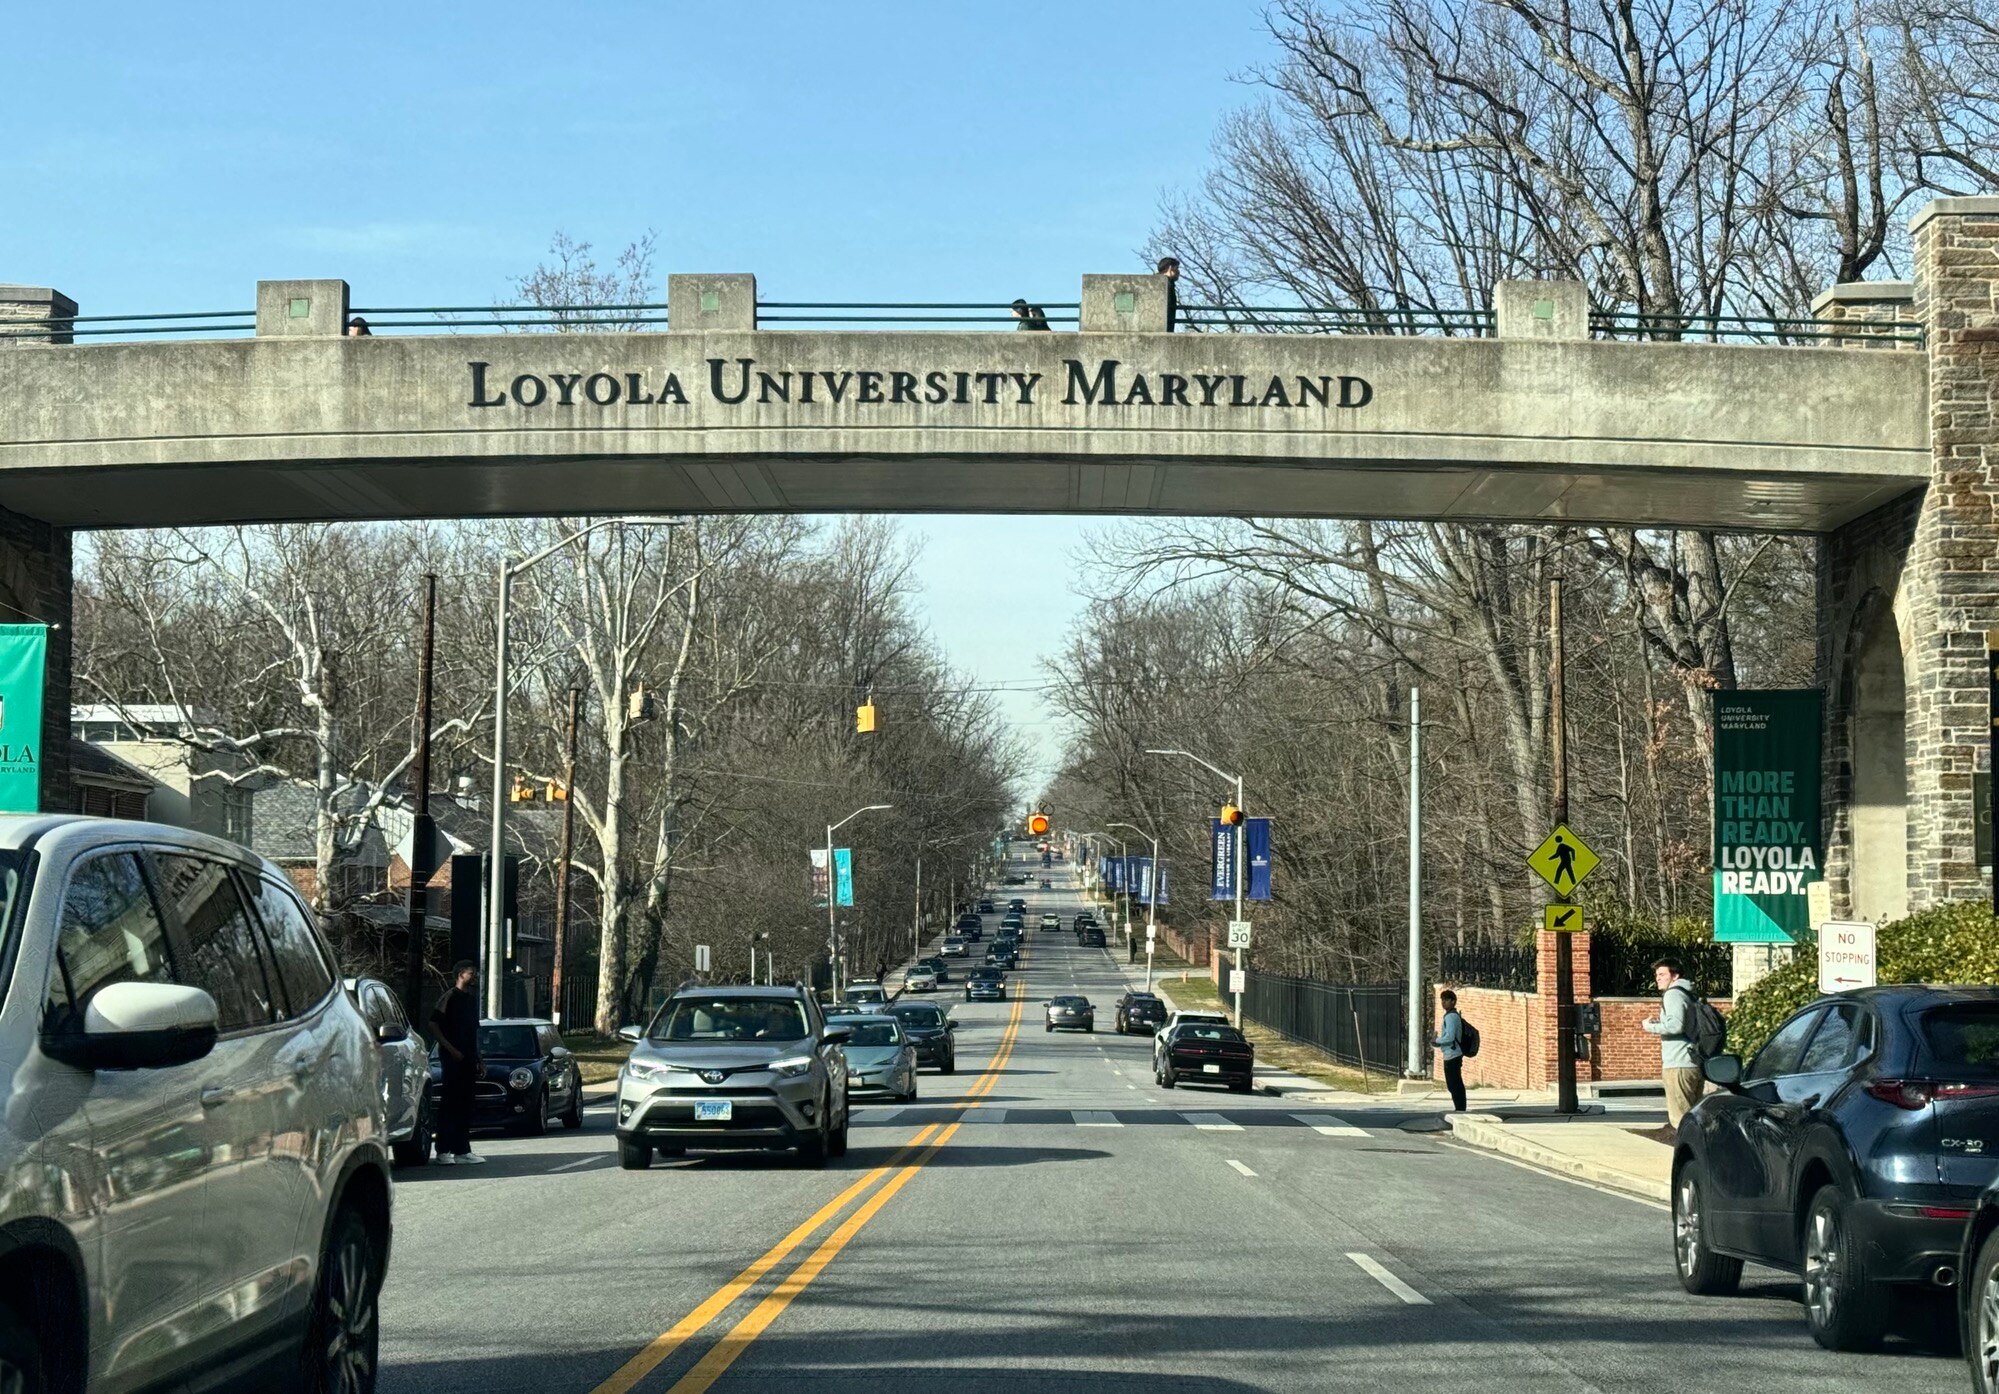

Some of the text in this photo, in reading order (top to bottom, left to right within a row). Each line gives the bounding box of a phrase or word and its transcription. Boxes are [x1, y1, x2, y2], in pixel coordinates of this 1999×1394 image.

[467, 358, 1374, 408] LOYOLA UNIVERSITY MARYLAND
[0, 745, 34, 762] LA
[1722, 771, 1794, 794] MORE
[1722, 796, 1789, 819] THAN
[1722, 821, 1806, 844] READY.
[1216, 831, 1225, 887] EVERGREEN
[1721, 846, 1816, 870] LOYOLA
[1721, 871, 1806, 895] READY.
[1231, 932, 1248, 943] 30
[1838, 933, 1856, 945] NO
[1825, 951, 1870, 965] STOPPING
[1941, 1138, 1984, 1148] CX-30
